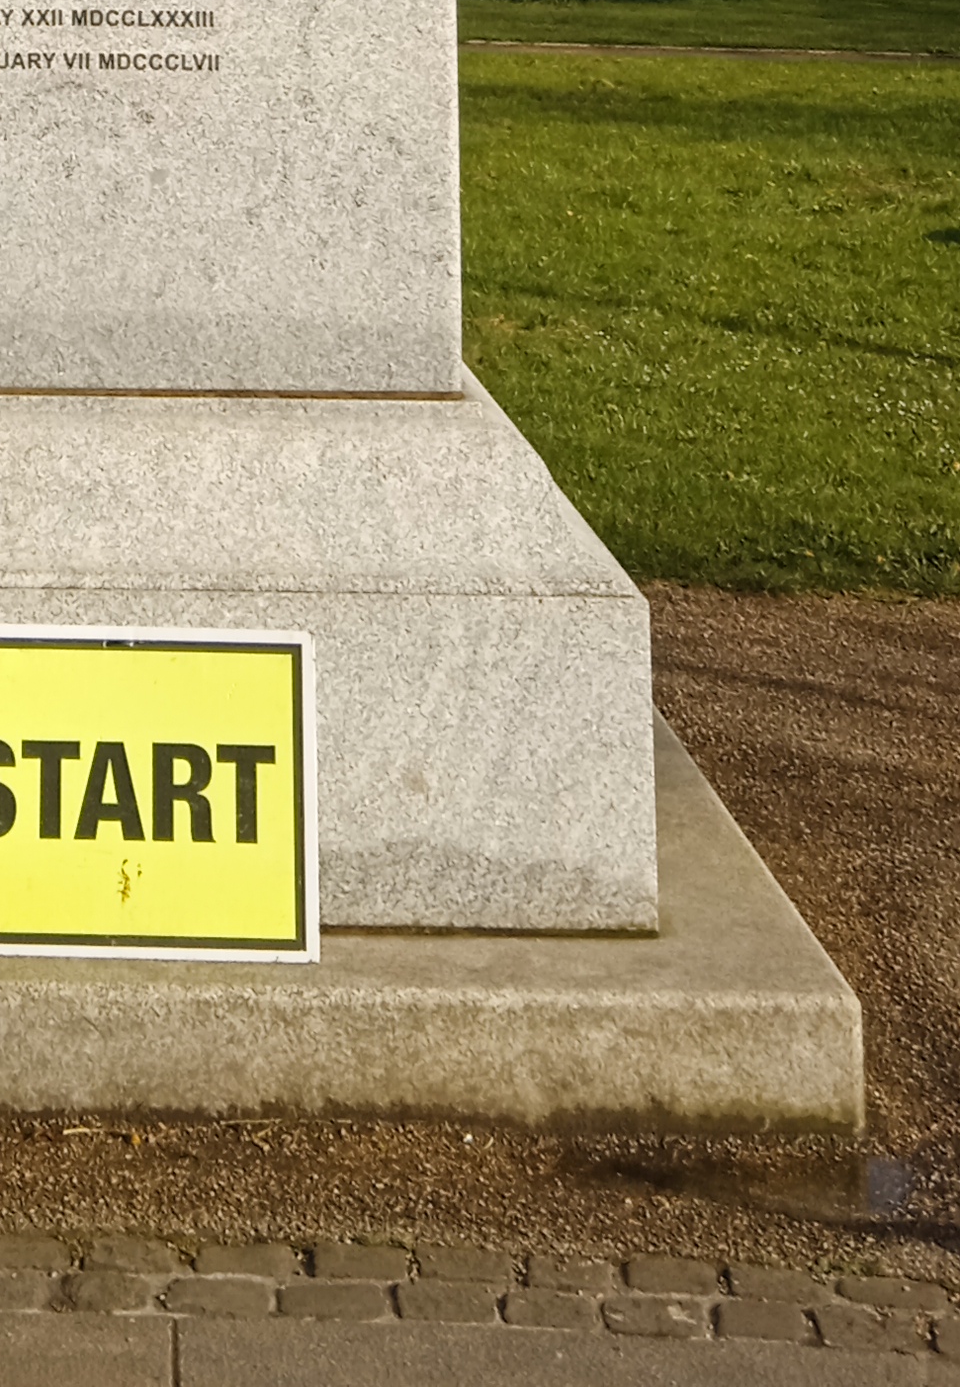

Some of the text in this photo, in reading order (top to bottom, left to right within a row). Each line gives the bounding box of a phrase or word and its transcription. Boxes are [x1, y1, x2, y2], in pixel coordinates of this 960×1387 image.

[21, 9, 64, 27] XXII
[71, 10, 214, 28] MDCCLXXXIII
[62, 53, 92, 71] VII
[99, 53, 221, 72] MDCCCLVII
